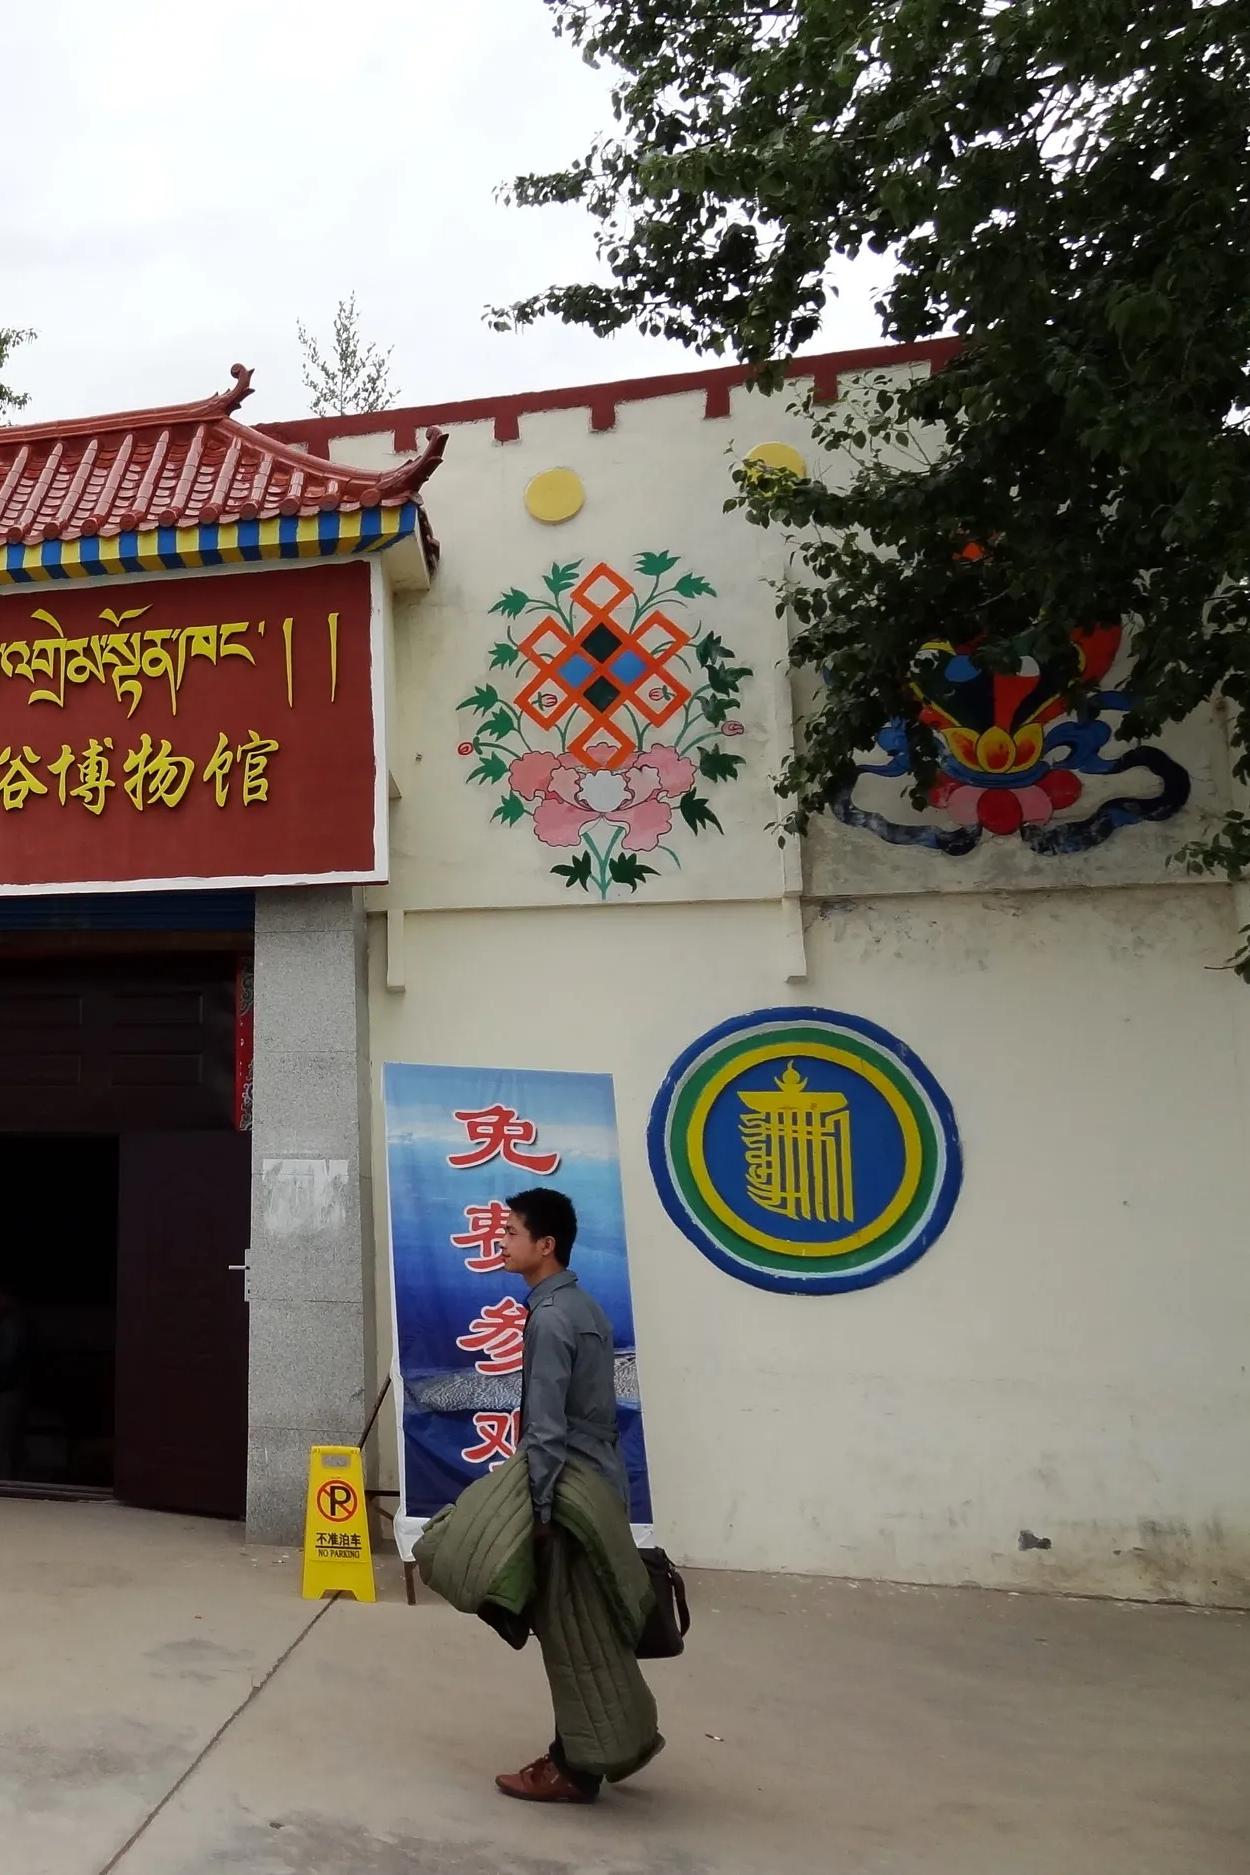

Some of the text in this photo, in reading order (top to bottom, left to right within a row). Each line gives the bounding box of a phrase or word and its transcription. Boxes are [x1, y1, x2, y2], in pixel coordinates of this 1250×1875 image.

[316, 1532, 361, 1546] 不准泊车
[318, 1549, 360, 1558] NO PARKING
